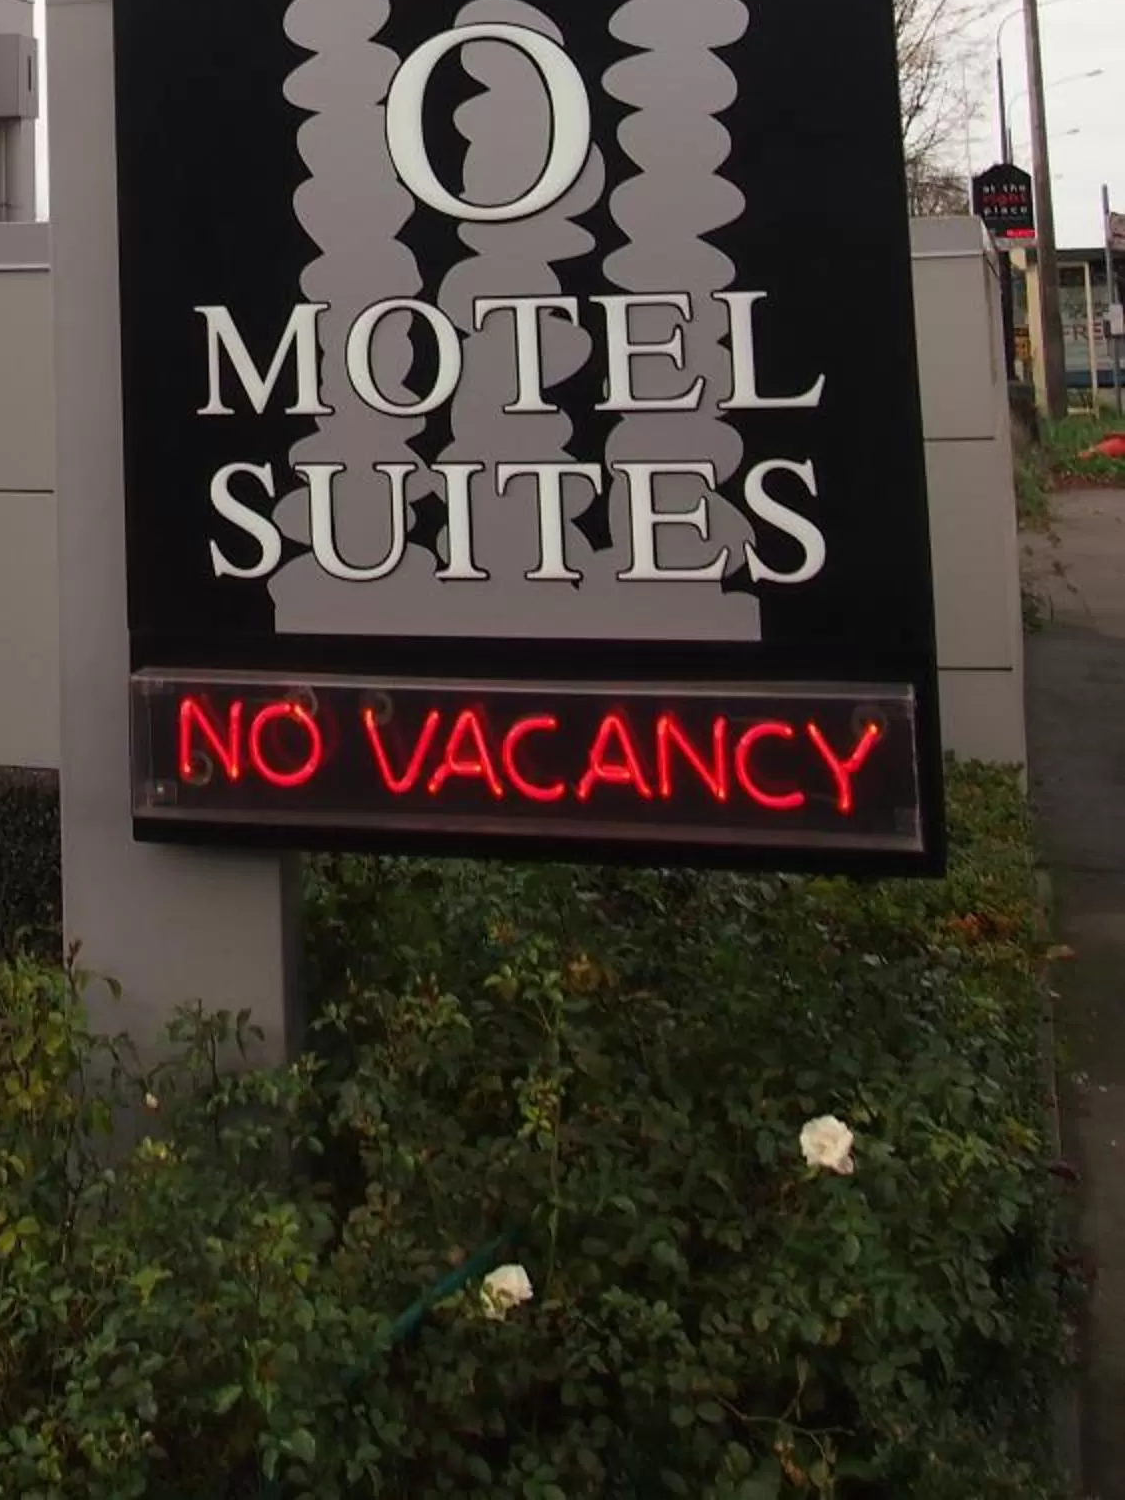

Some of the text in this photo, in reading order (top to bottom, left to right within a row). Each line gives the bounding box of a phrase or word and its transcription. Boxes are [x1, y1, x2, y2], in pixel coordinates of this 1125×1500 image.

[193, 289, 826, 418] MOTEL
[208, 457, 827, 585] SUITES
[178, 696, 881, 813] NO VACANCY
